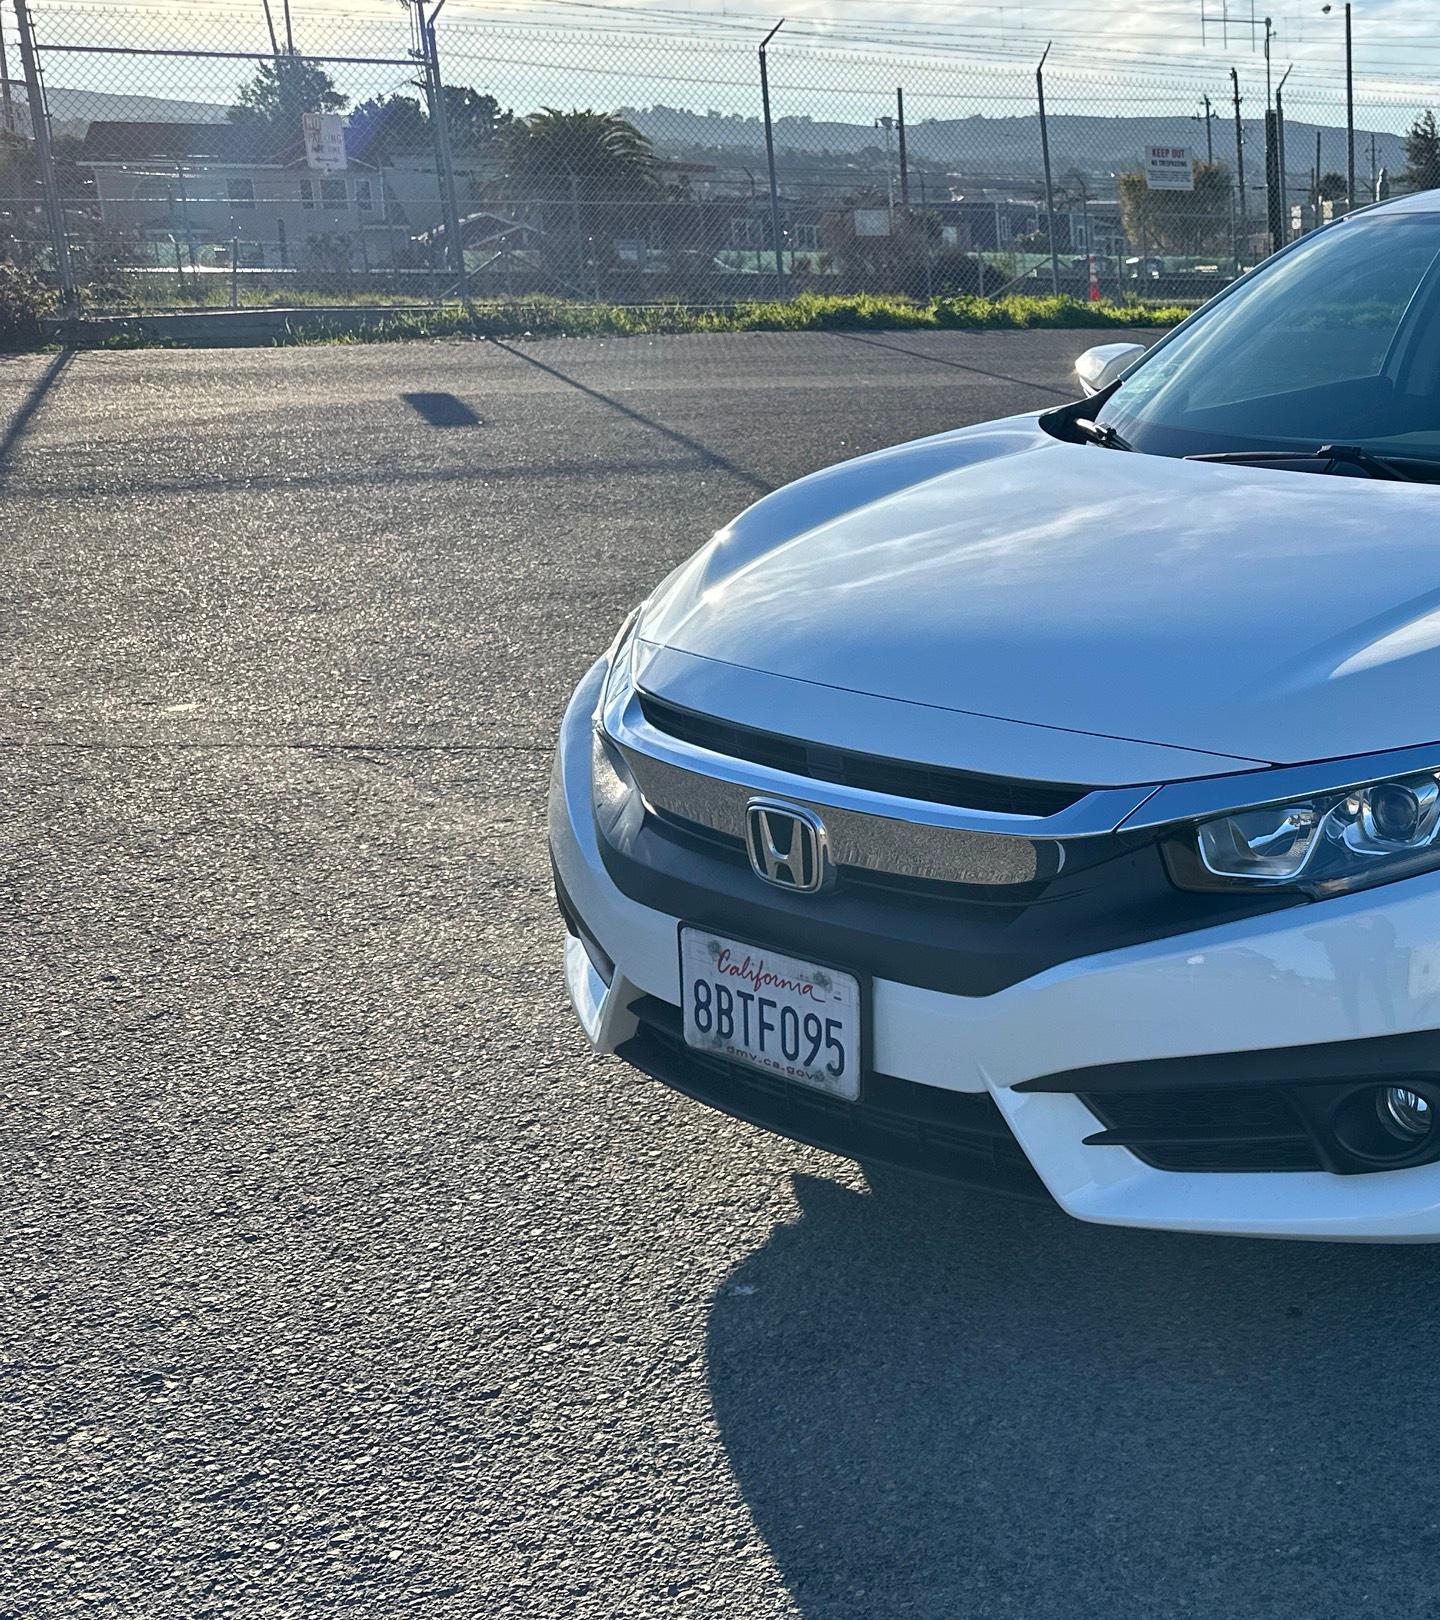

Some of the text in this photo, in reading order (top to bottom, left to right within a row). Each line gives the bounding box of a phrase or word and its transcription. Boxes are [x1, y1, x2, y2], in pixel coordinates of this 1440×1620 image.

[304, 116, 319, 129] NO
[1152, 149, 1185, 159] KEEP OUT
[716, 949, 826, 1003] California
[693, 978, 845, 1077] 8BTF095
[726, 1045, 815, 1081] dmv.ca.gov
